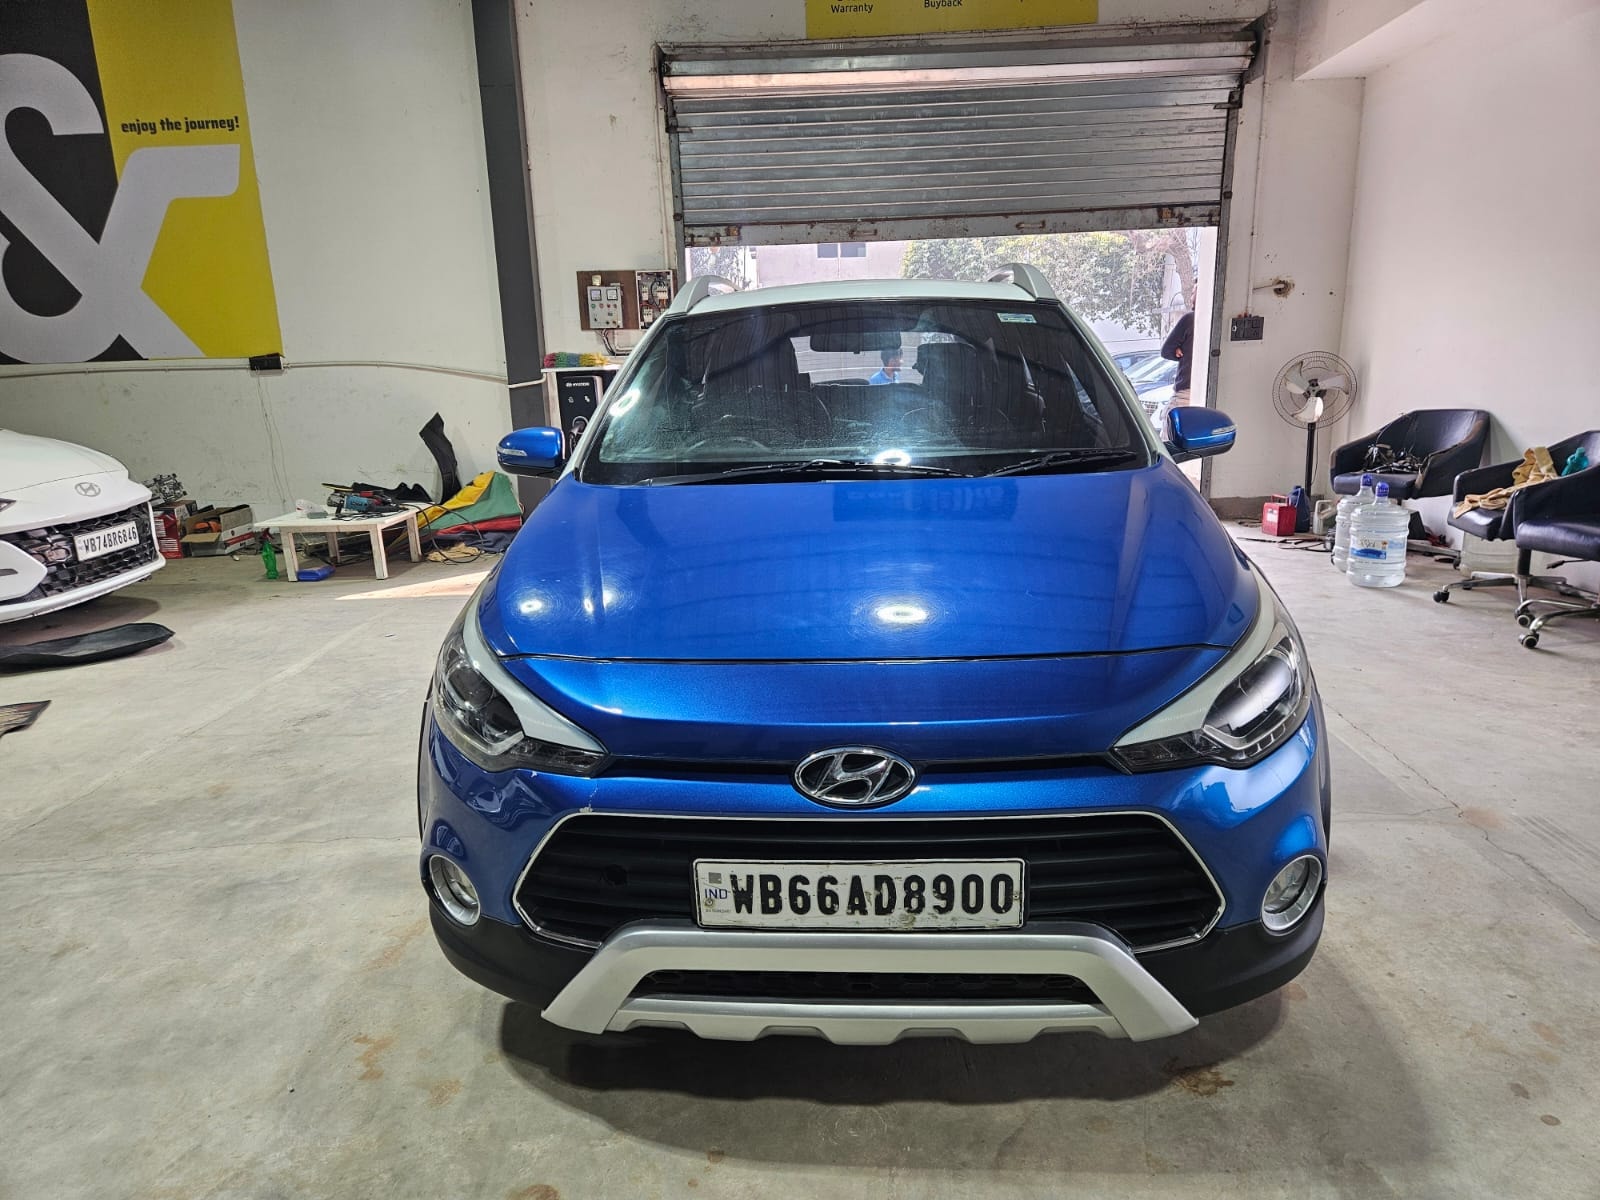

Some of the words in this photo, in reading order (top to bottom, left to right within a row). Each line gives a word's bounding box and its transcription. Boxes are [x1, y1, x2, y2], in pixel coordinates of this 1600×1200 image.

[831, 3, 874, 14] Warranty
[924, 0, 963, 9] Buyback
[121, 119, 157, 135] enjoy
[160, 118, 182, 131] the
[184, 116, 240, 133] journey!
[83, 526, 137, 554] WB74BR6846
[705, 888, 728, 899] IND
[729, 874, 1014, 915] WB66AD8900
